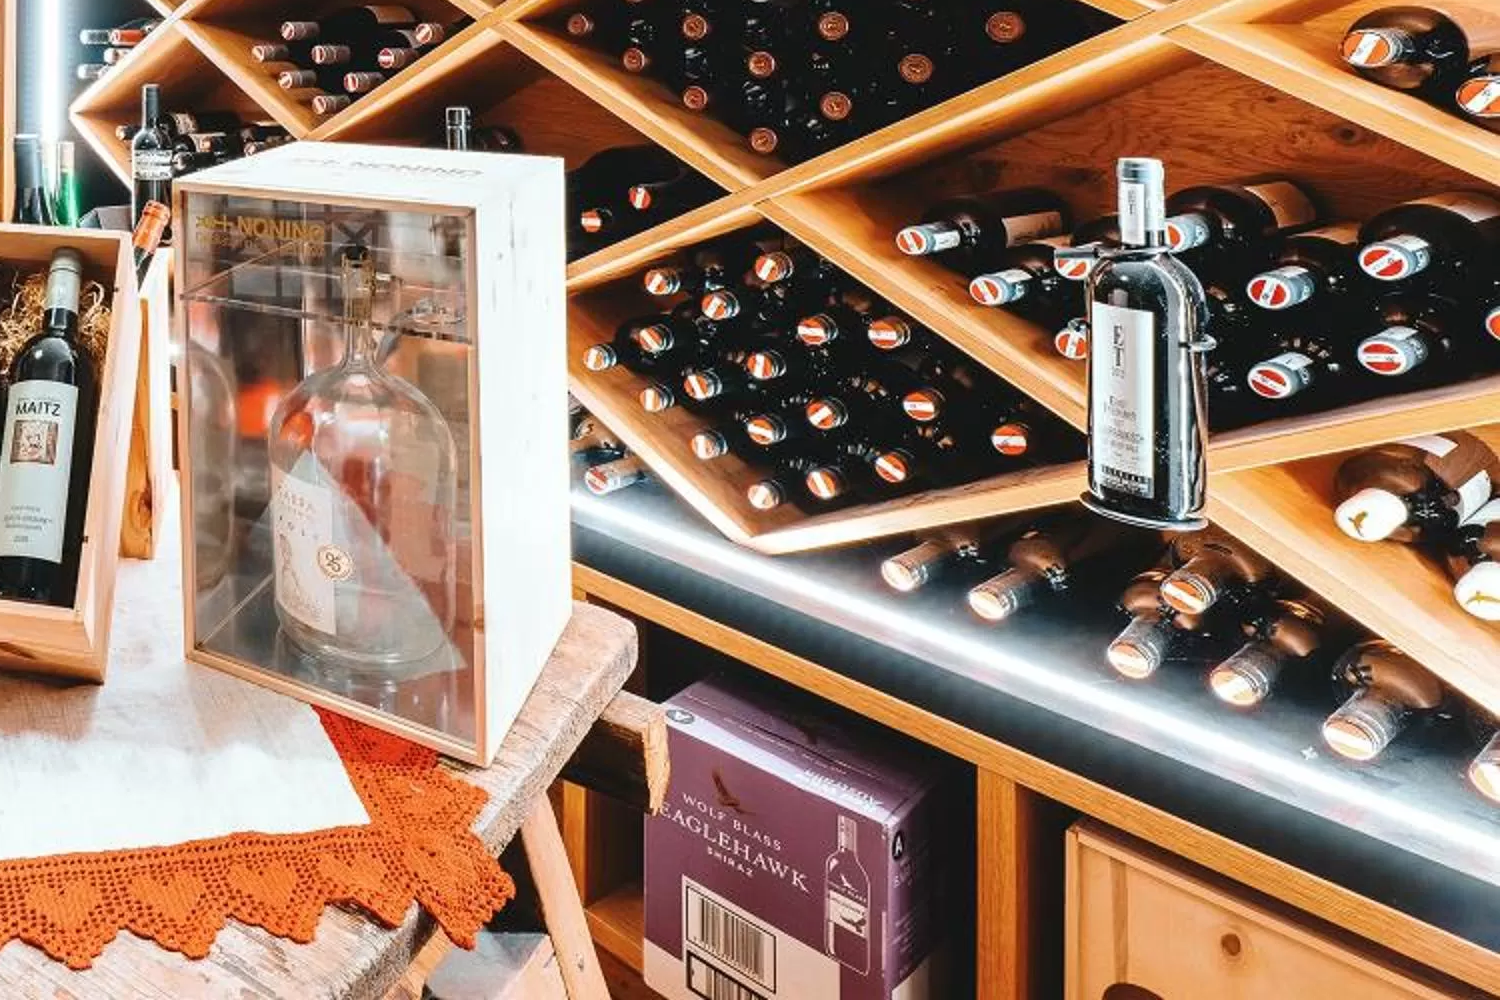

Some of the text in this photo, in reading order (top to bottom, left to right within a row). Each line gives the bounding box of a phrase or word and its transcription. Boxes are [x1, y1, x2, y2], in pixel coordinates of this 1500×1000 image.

[237, 215, 325, 242] NONINO
[15, 401, 62, 417] MAITZ
[682, 793, 781, 851] WOLF BLASS
[660, 802, 812, 896] EAGLEHAWK
[707, 846, 754, 879] SHIRAZ
